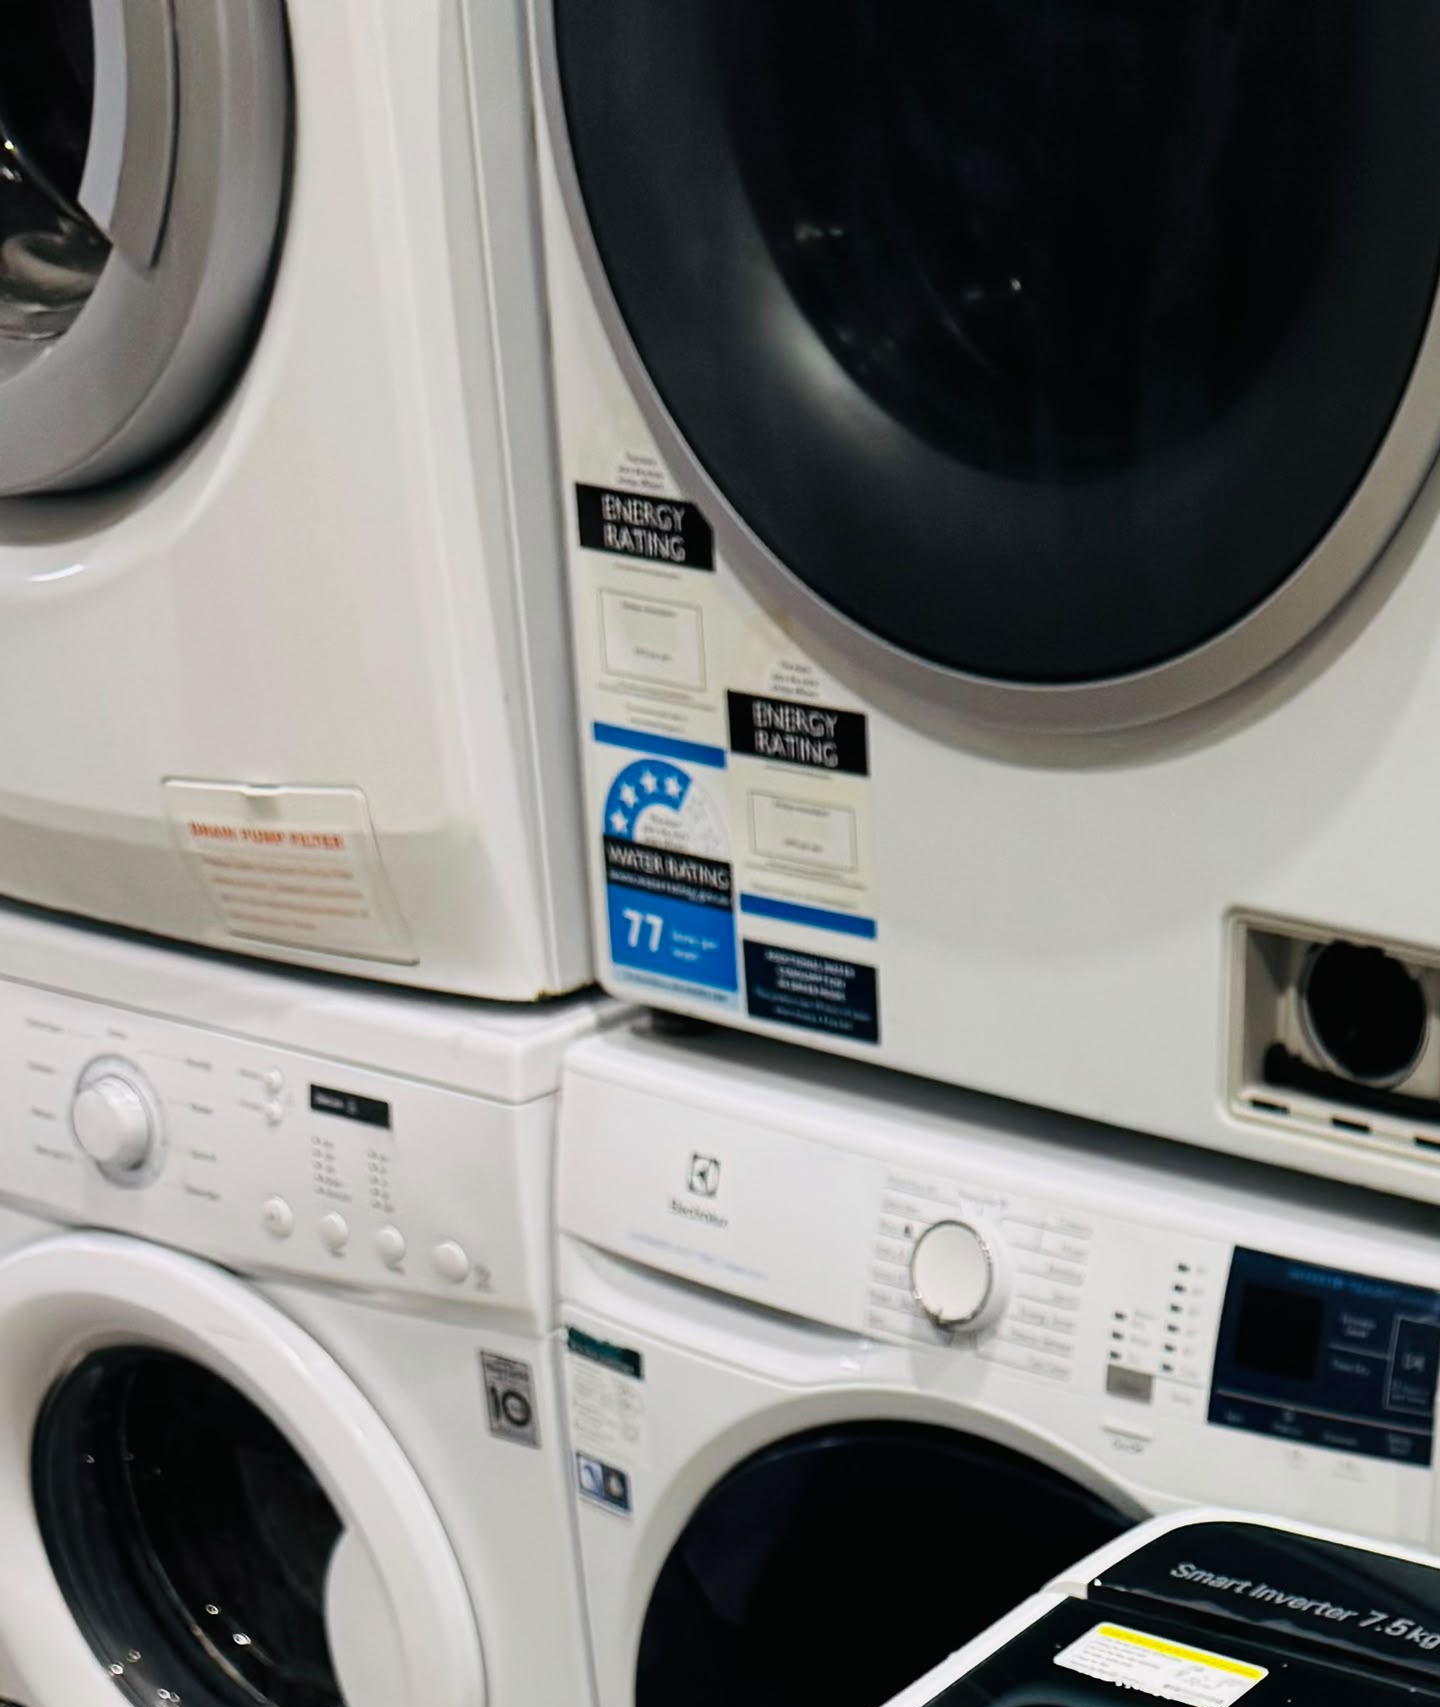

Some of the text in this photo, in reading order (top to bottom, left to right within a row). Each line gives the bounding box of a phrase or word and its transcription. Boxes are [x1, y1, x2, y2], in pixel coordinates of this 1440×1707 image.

[601, 493, 685, 532] ENERGY
[603, 522, 686, 562] RATING
[752, 701, 838, 737] ENERGY
[754, 729, 838, 768] RATING
[608, 844, 664, 875] WATER
[622, 907, 663, 952] 77
[1170, 1562, 1254, 1594] Smart
[1249, 1583, 1359, 1622] Inverter
